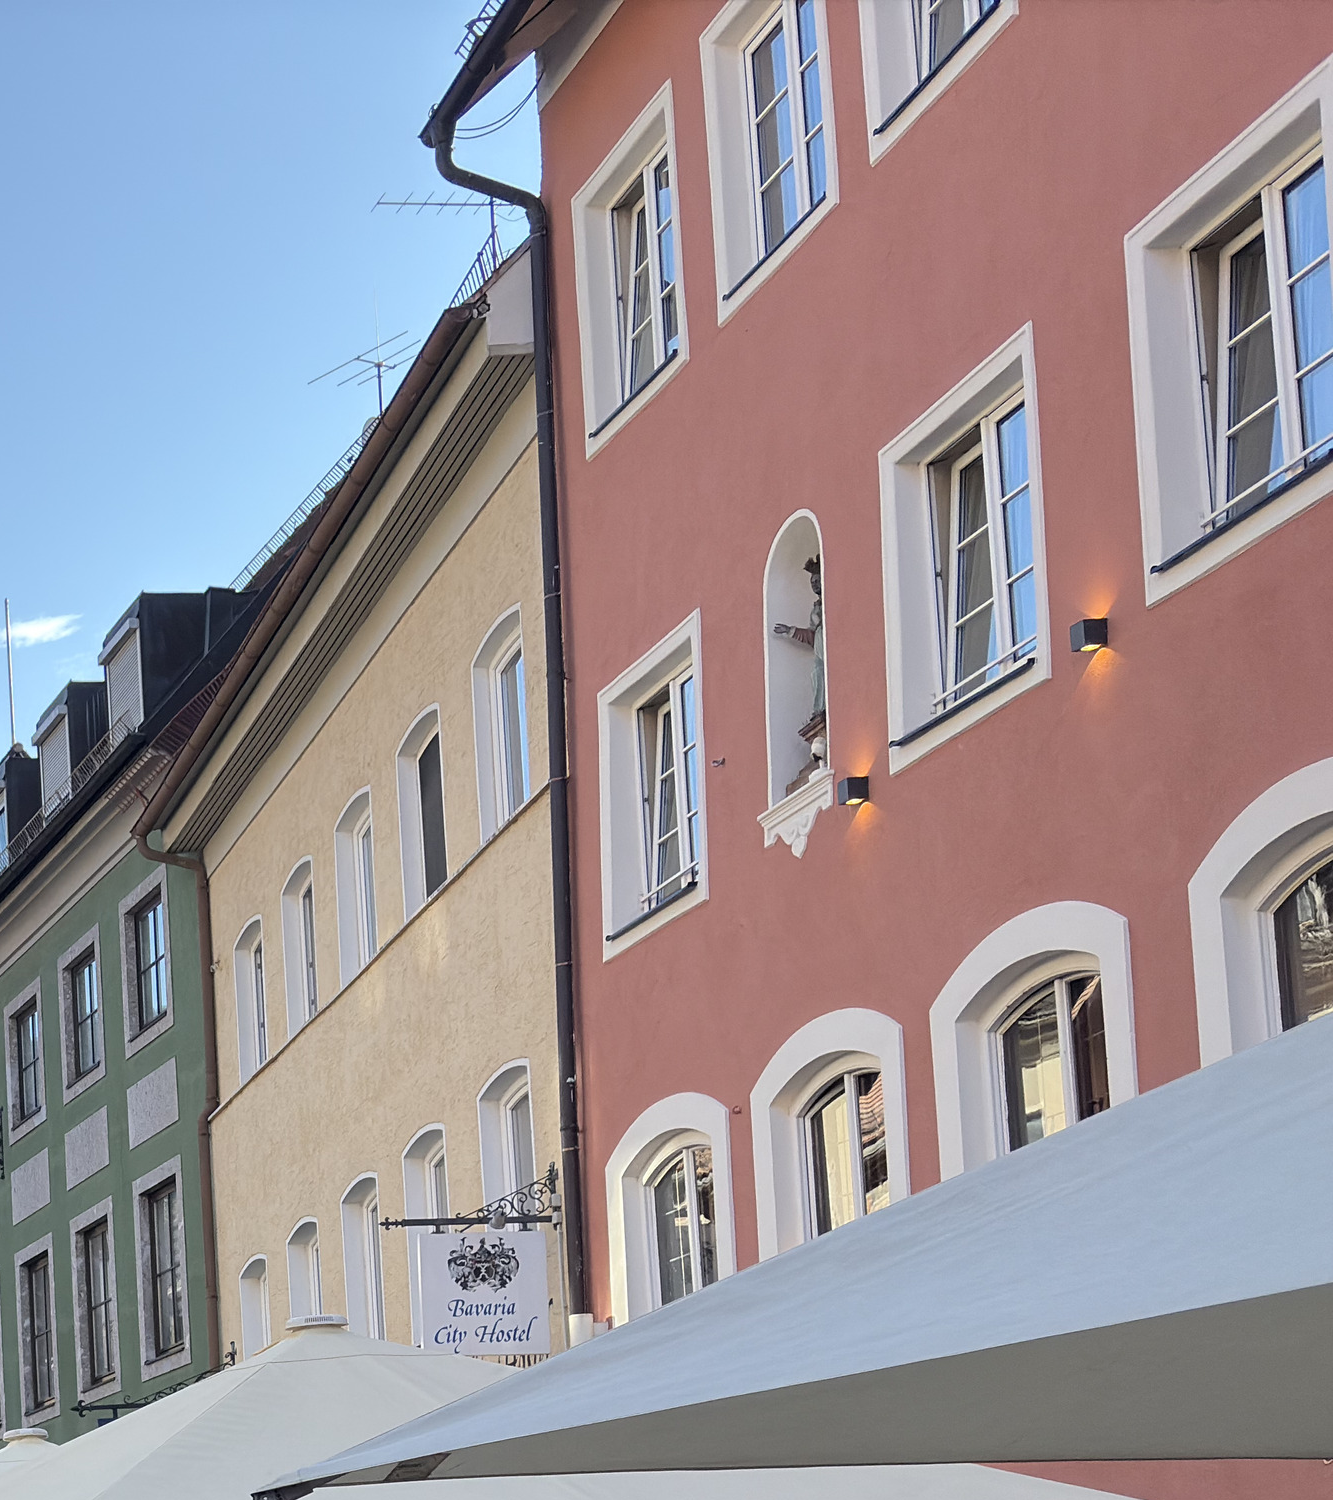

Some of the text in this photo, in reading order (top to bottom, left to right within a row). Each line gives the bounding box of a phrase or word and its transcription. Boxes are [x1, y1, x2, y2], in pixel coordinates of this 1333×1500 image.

[447, 1296, 517, 1318] Bavaria
[434, 1316, 538, 1355] City Hostel
